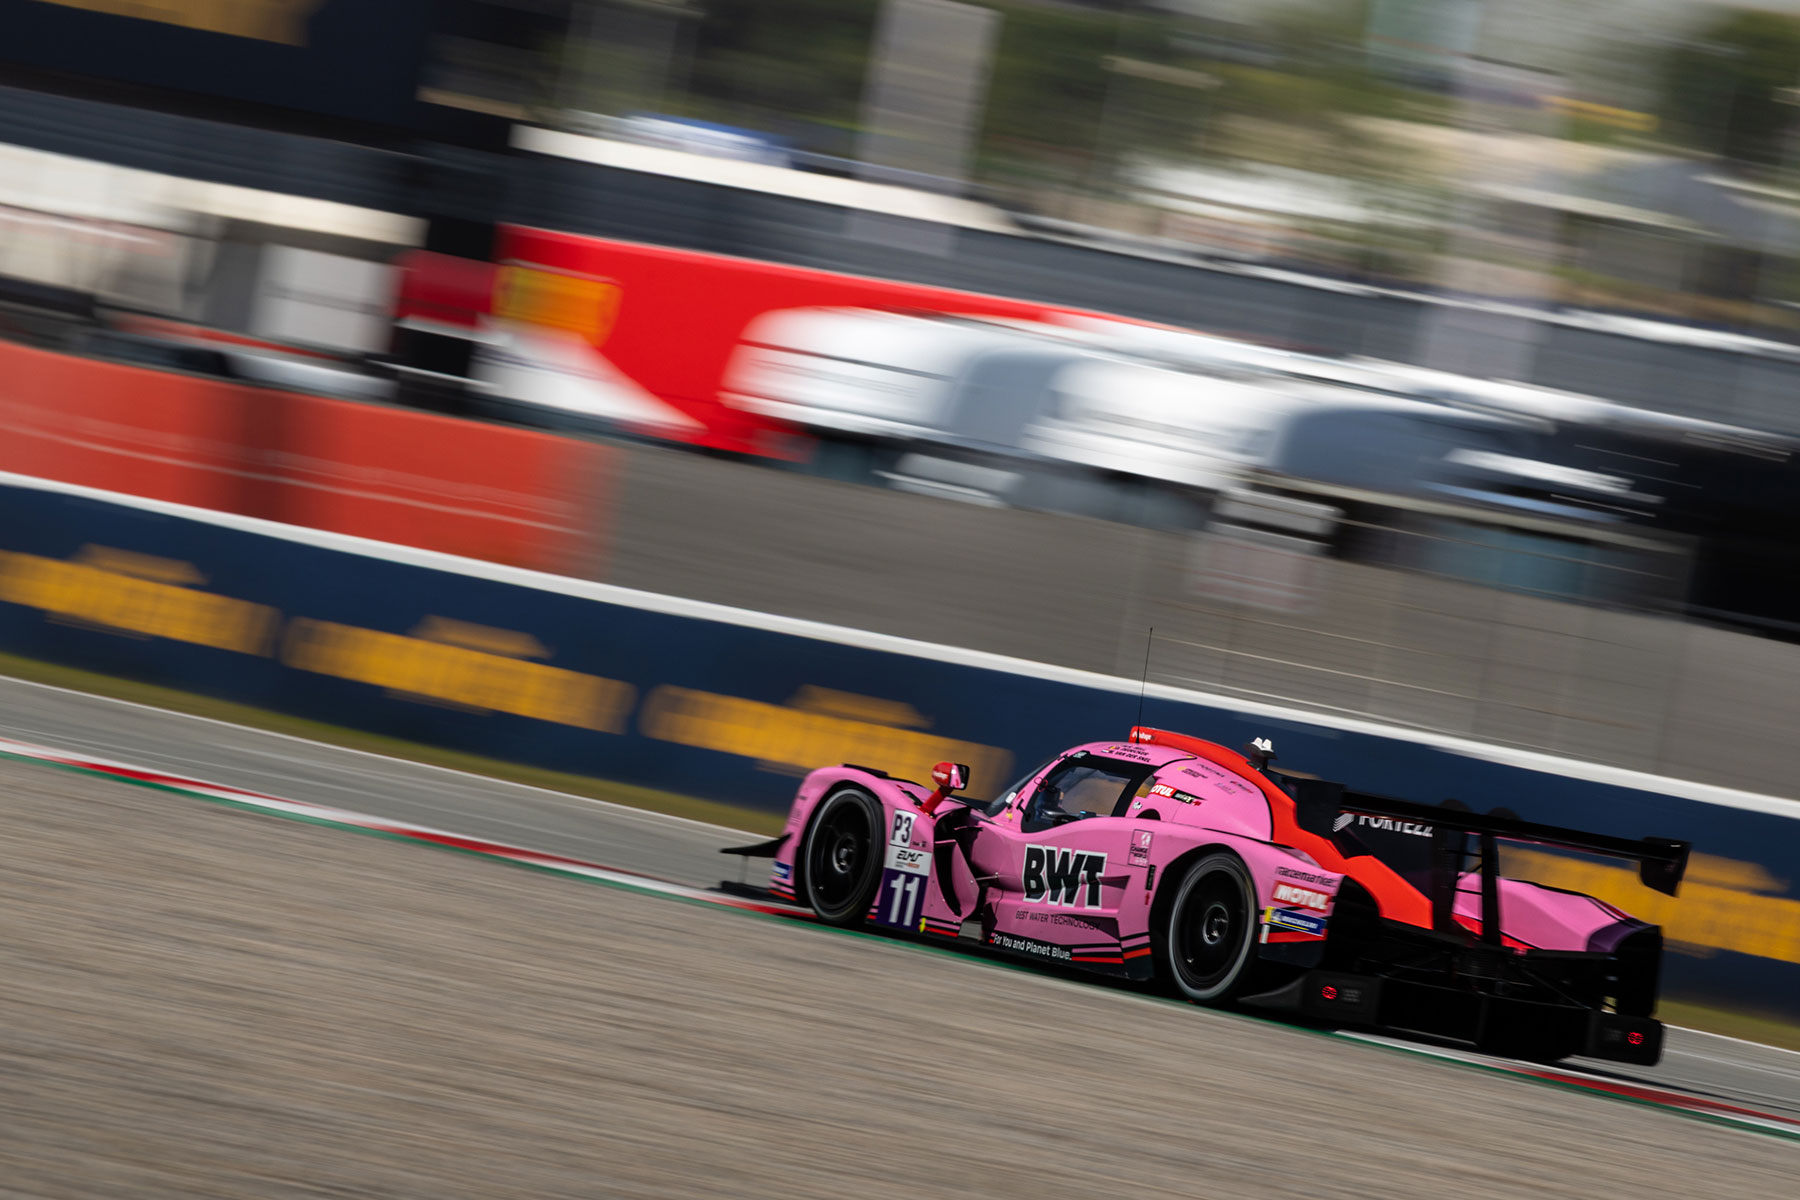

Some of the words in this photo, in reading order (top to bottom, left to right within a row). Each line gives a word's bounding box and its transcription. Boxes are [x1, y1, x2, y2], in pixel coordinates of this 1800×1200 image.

[891, 813, 912, 844] P3
[1023, 844, 1108, 910] BWT
[889, 873, 920, 927] 11
[1273, 884, 1329, 910] MOTUL
[1015, 910, 1029, 920] BEST
[1029, 911, 1049, 923] WATER
[994, 933, 1003, 944] For
[1002, 935, 1013, 948] You
[1012, 939, 1026, 951] and
[1026, 941, 1050, 956] Planet
